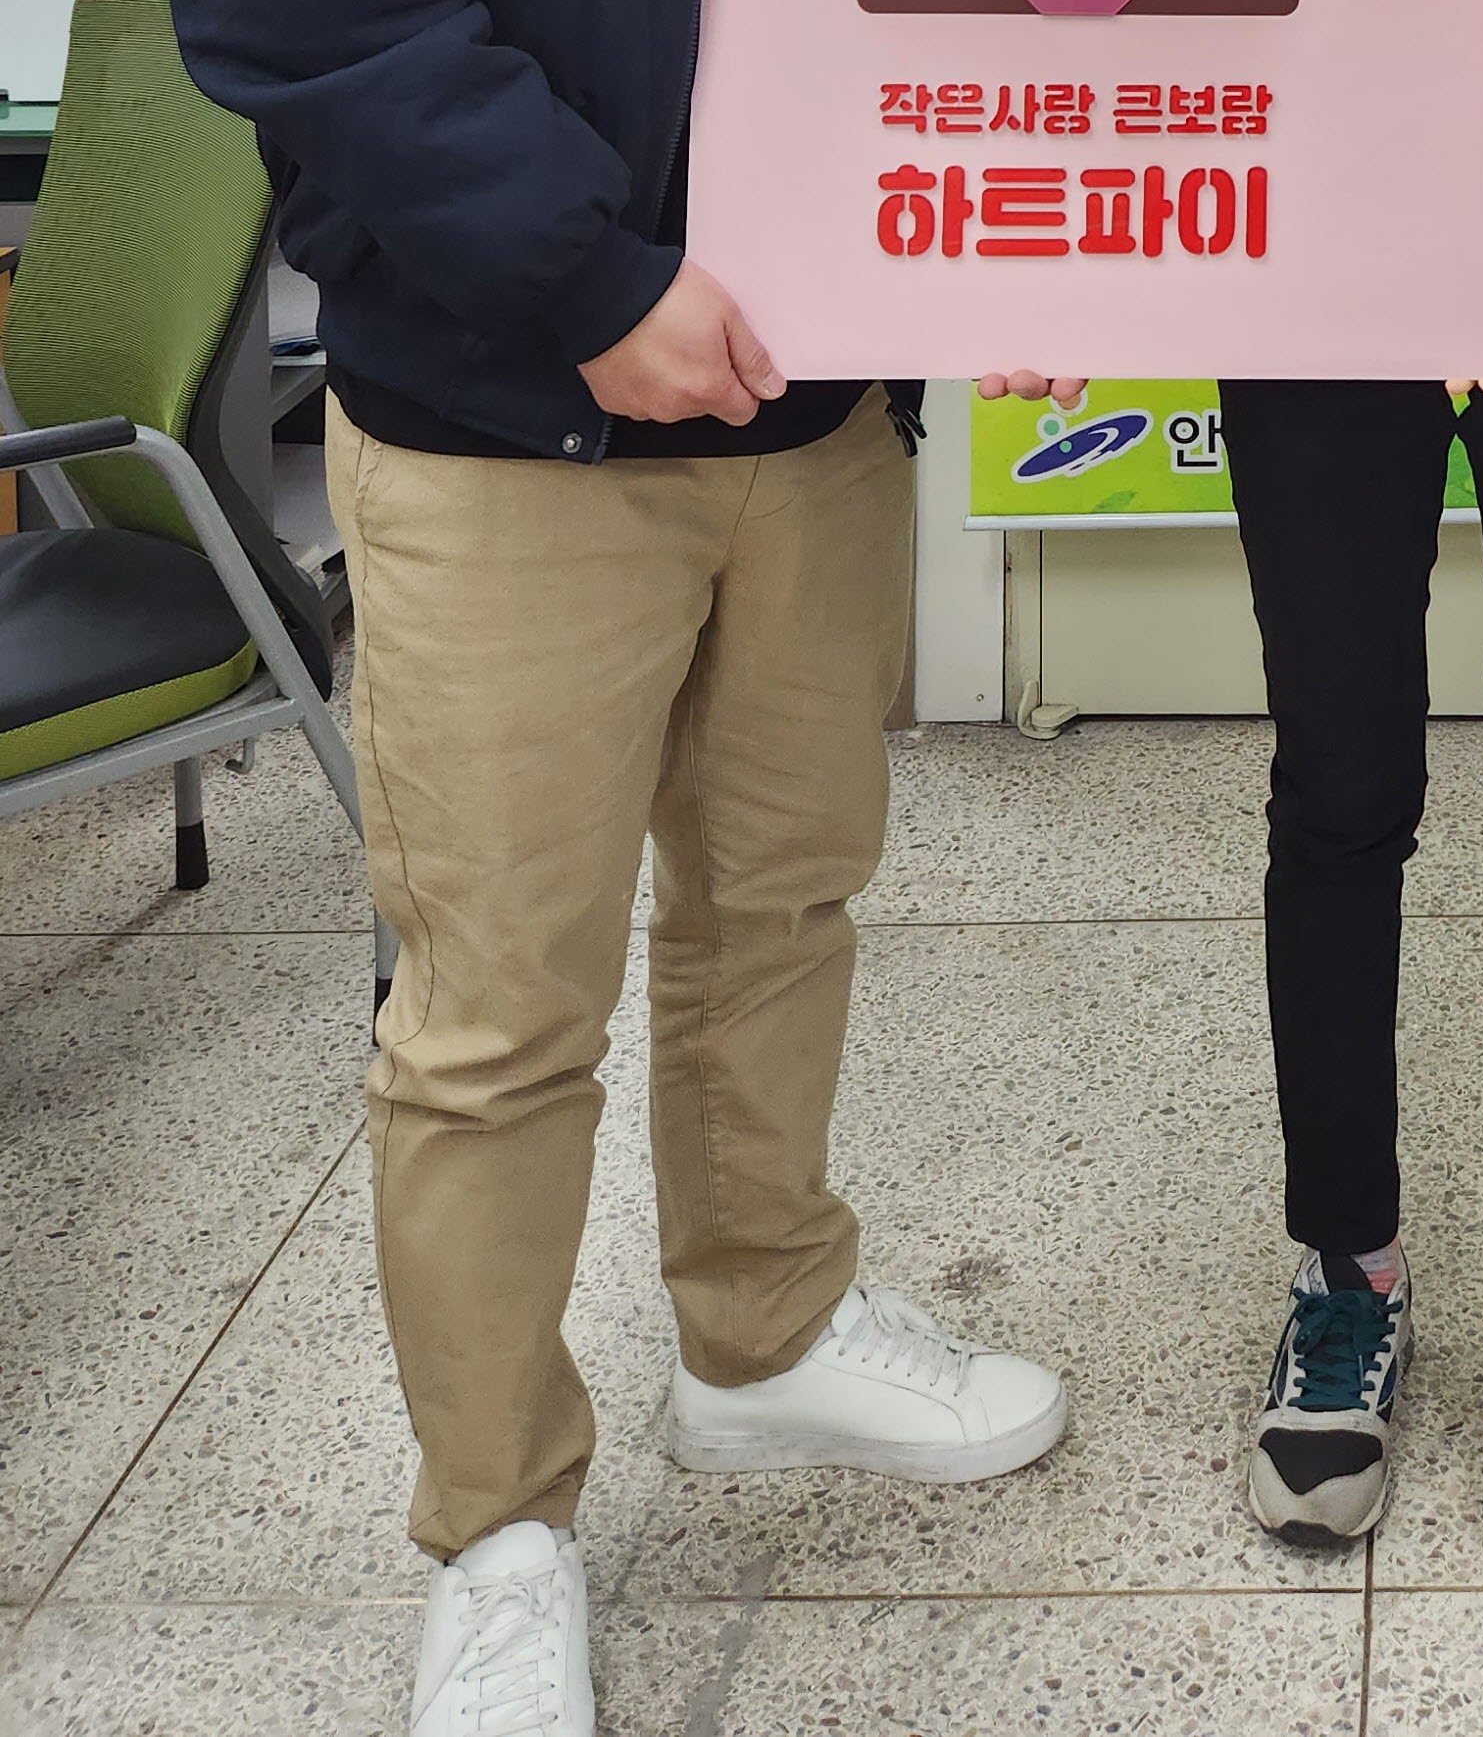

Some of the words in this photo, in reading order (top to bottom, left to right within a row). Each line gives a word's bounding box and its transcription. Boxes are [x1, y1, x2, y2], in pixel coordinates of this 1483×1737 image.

[878, 83, 1097, 136] 작은사랑
[1111, 83, 1274, 136] 큰보람
[876, 164, 1269, 259] 하트파이
